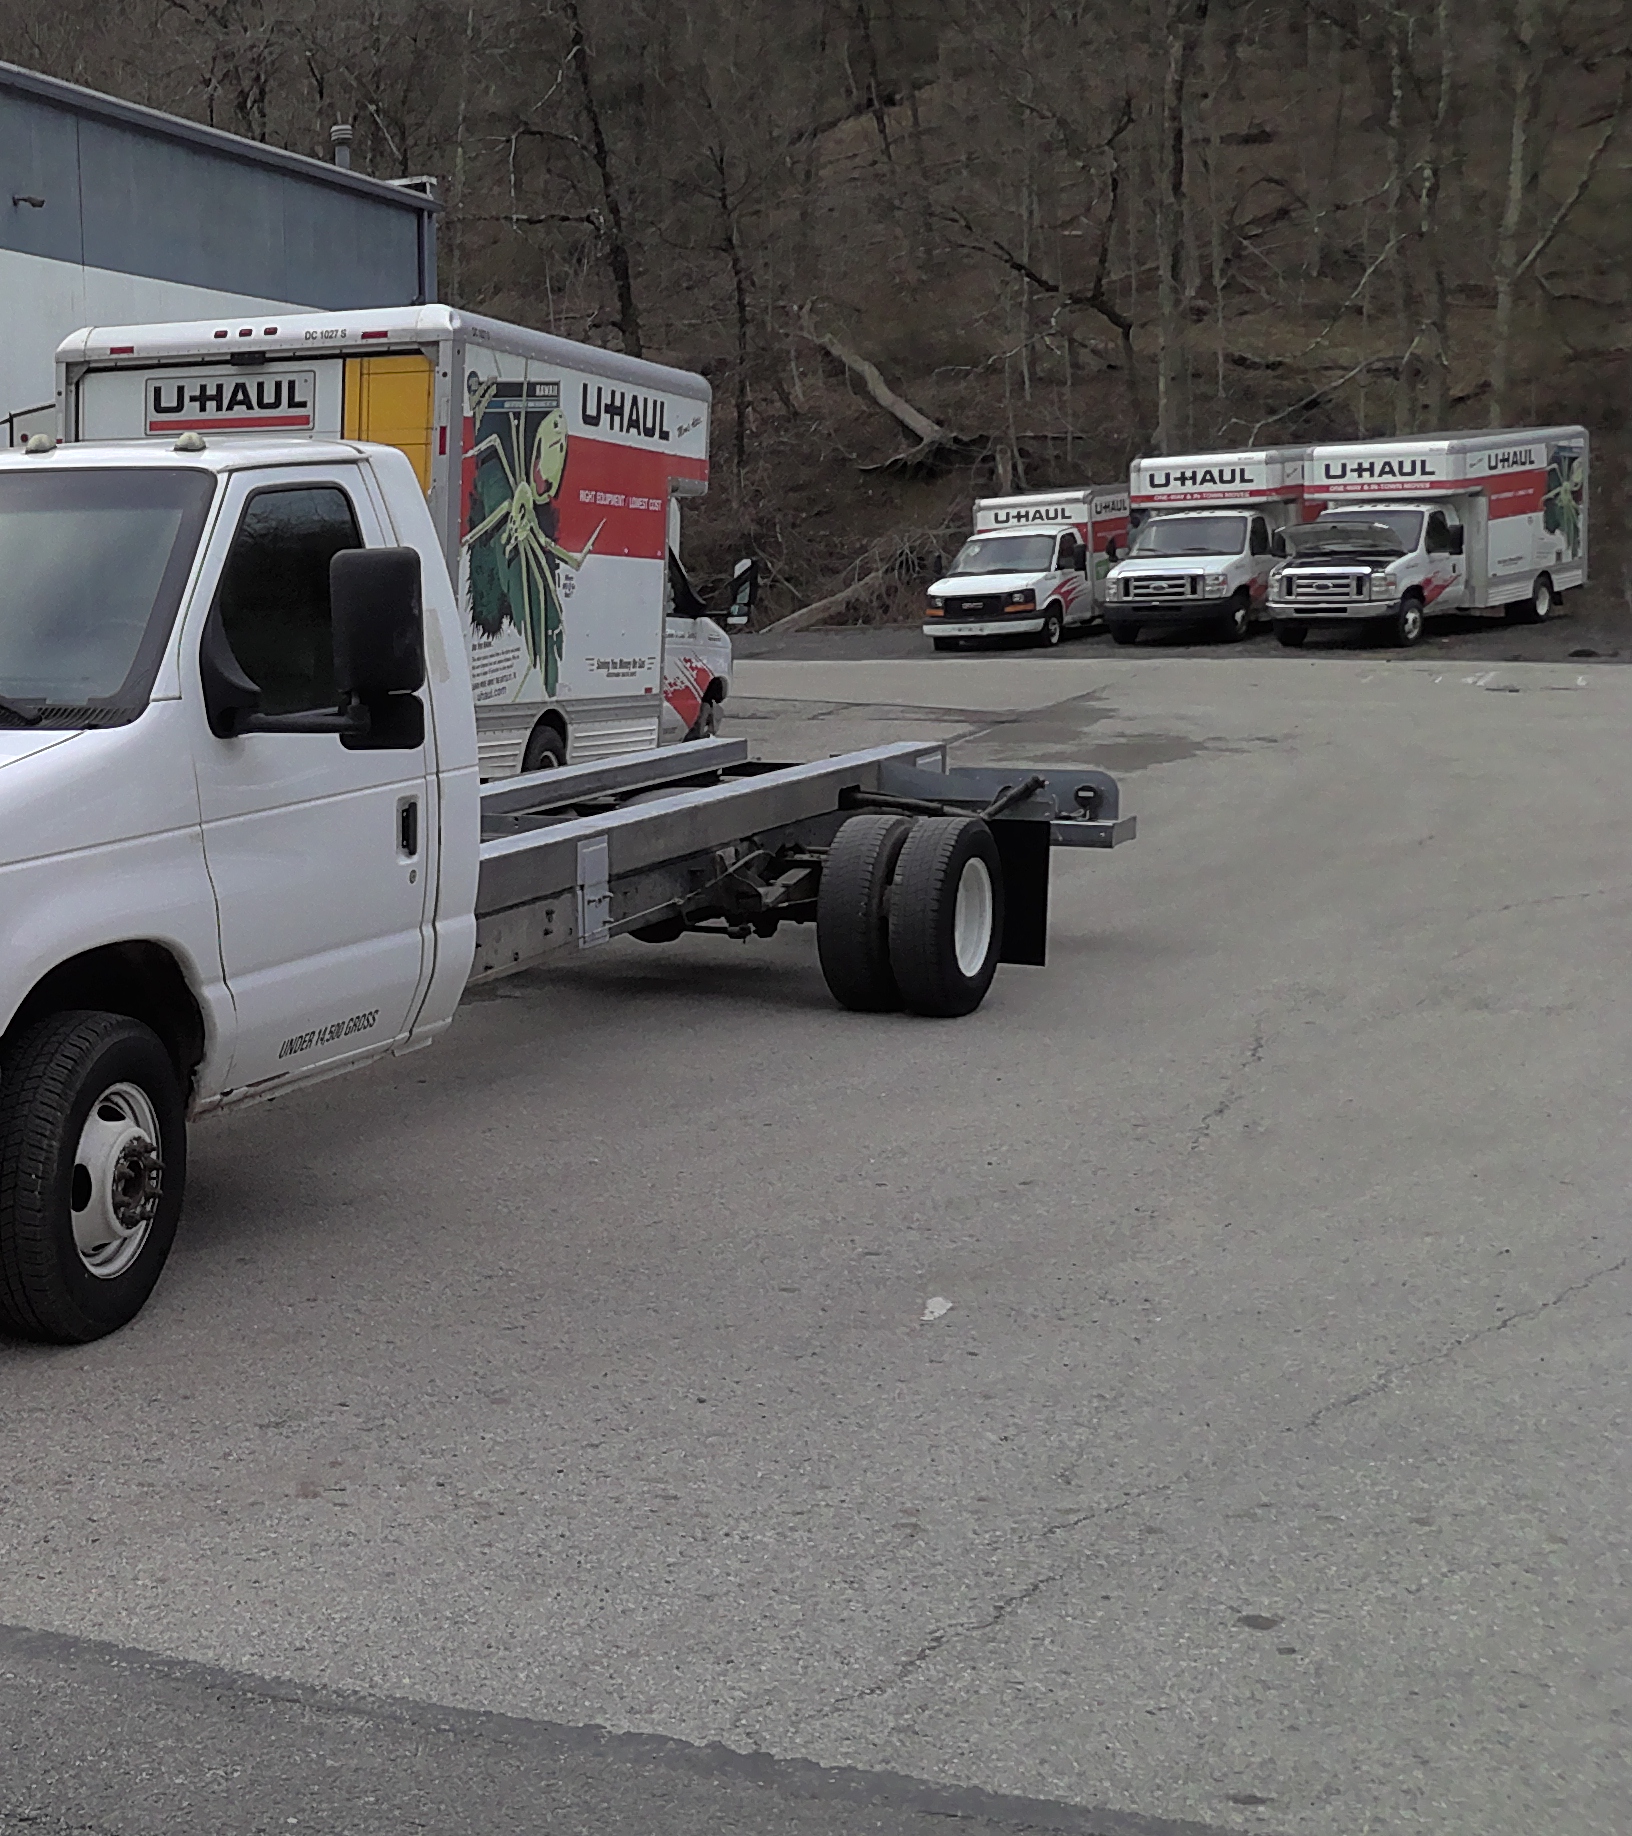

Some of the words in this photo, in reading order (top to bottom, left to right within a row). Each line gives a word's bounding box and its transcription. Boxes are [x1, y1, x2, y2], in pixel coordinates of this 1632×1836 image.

[305, 330, 318, 341] DC
[320, 330, 339, 340] 1027
[340, 329, 348, 339] S
[153, 379, 308, 414] U-HAUL
[582, 382, 670, 440] U-HAUL
[1324, 459, 1435, 480] U-HAUL
[1487, 448, 1535, 471] U-HAUL
[1149, 467, 1254, 489] U-HAUL
[994, 508, 1072, 525] U-HAUL
[1094, 498, 1127, 515] U-HAUL
[278, 1030, 316, 1059] UNDER
[315, 1020, 345, 1047] 14,500
[343, 1009, 380, 1037] GROSS
